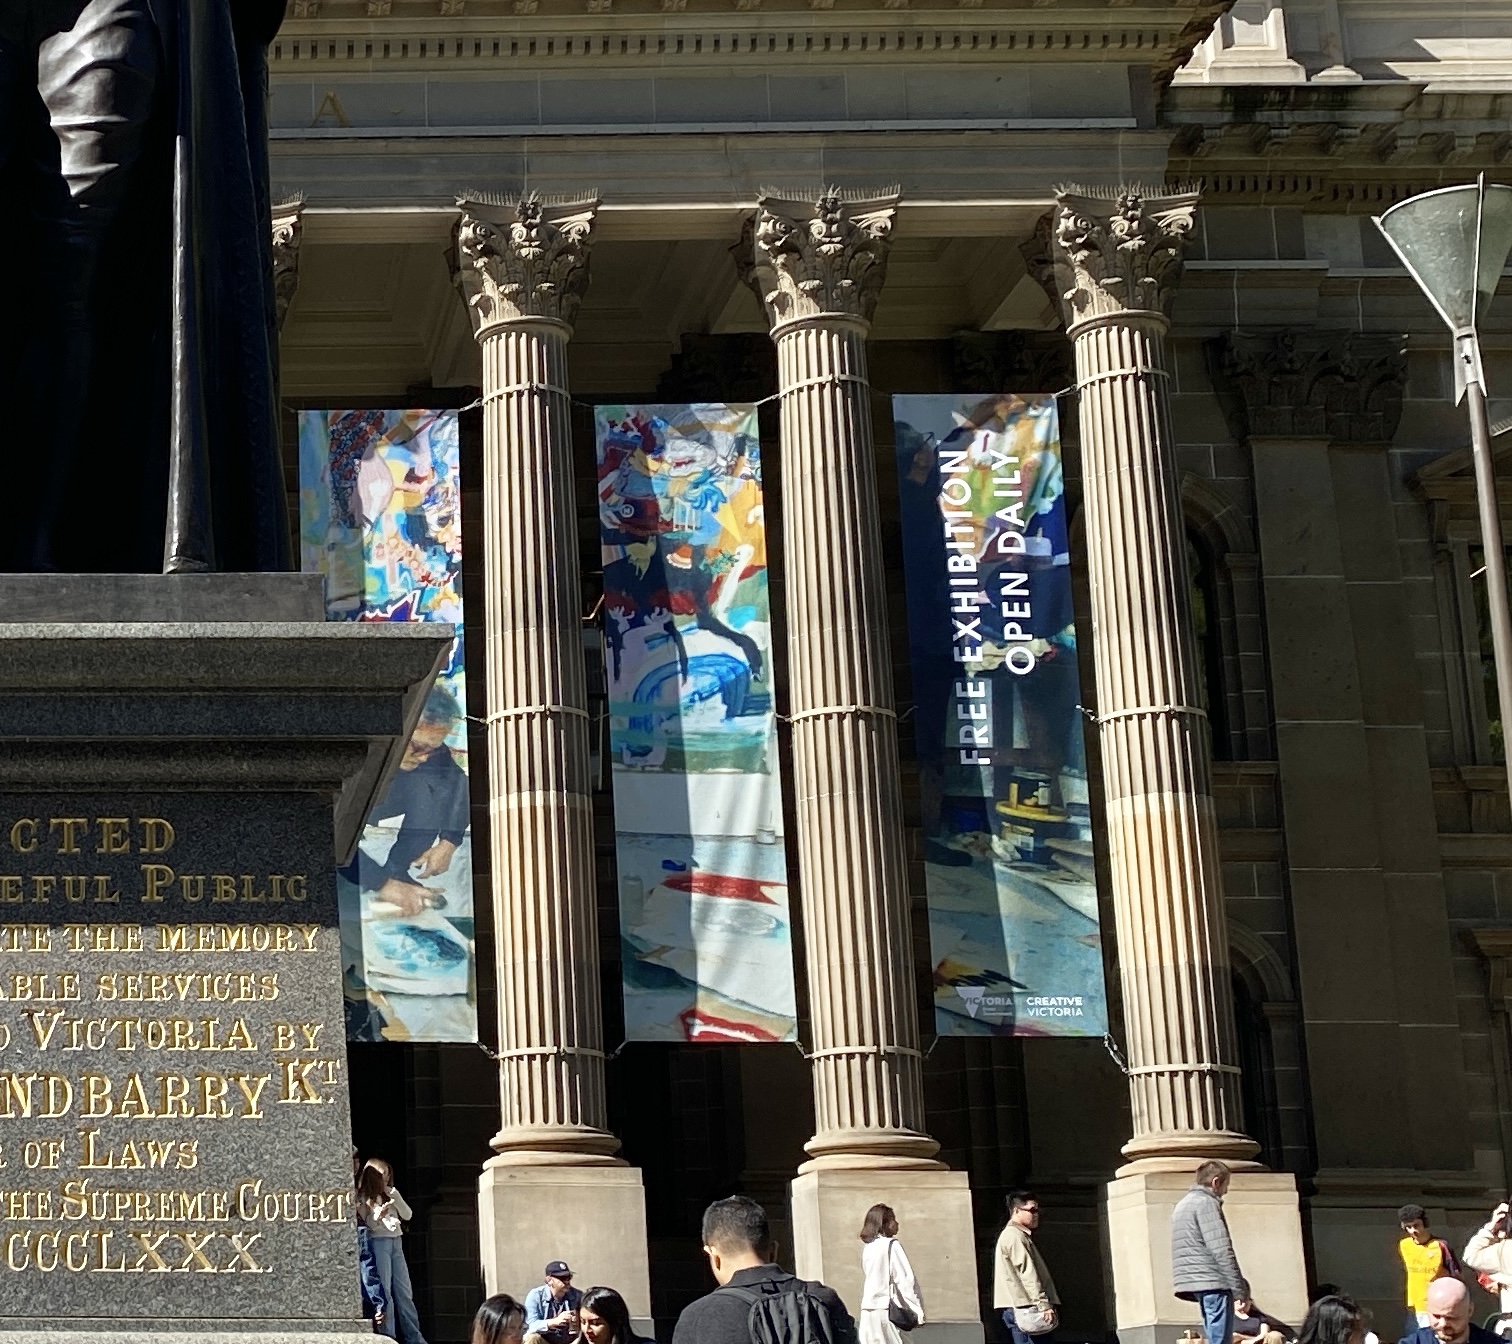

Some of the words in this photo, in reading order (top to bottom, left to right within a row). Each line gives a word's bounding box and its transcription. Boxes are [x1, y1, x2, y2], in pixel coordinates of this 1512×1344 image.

[990, 448, 1026, 554] DAILY
[939, 450, 983, 663] EXHIBITION
[999, 572, 1035, 675] OPEN
[956, 680, 991, 765] FREE
[140, 863, 308, 903] PUBLIC
[62, 925, 143, 952] THE
[156, 925, 319, 952] MEMORY
[95, 974, 280, 1001] SERVICES
[1026, 997, 1083, 1006] CREATIVE
[20, 1010, 259, 1052] VICTORIA
[271, 1023, 324, 1052] BY
[1027, 1007, 1084, 1017] VICTORIA
[81, 1072, 271, 1119] BARRY
[24, 1140, 66, 1169] OF
[77, 1129, 199, 1169] LAWS
[57, 1178, 229, 1222] SUPREME
[235, 1178, 351, 1223] COURT
